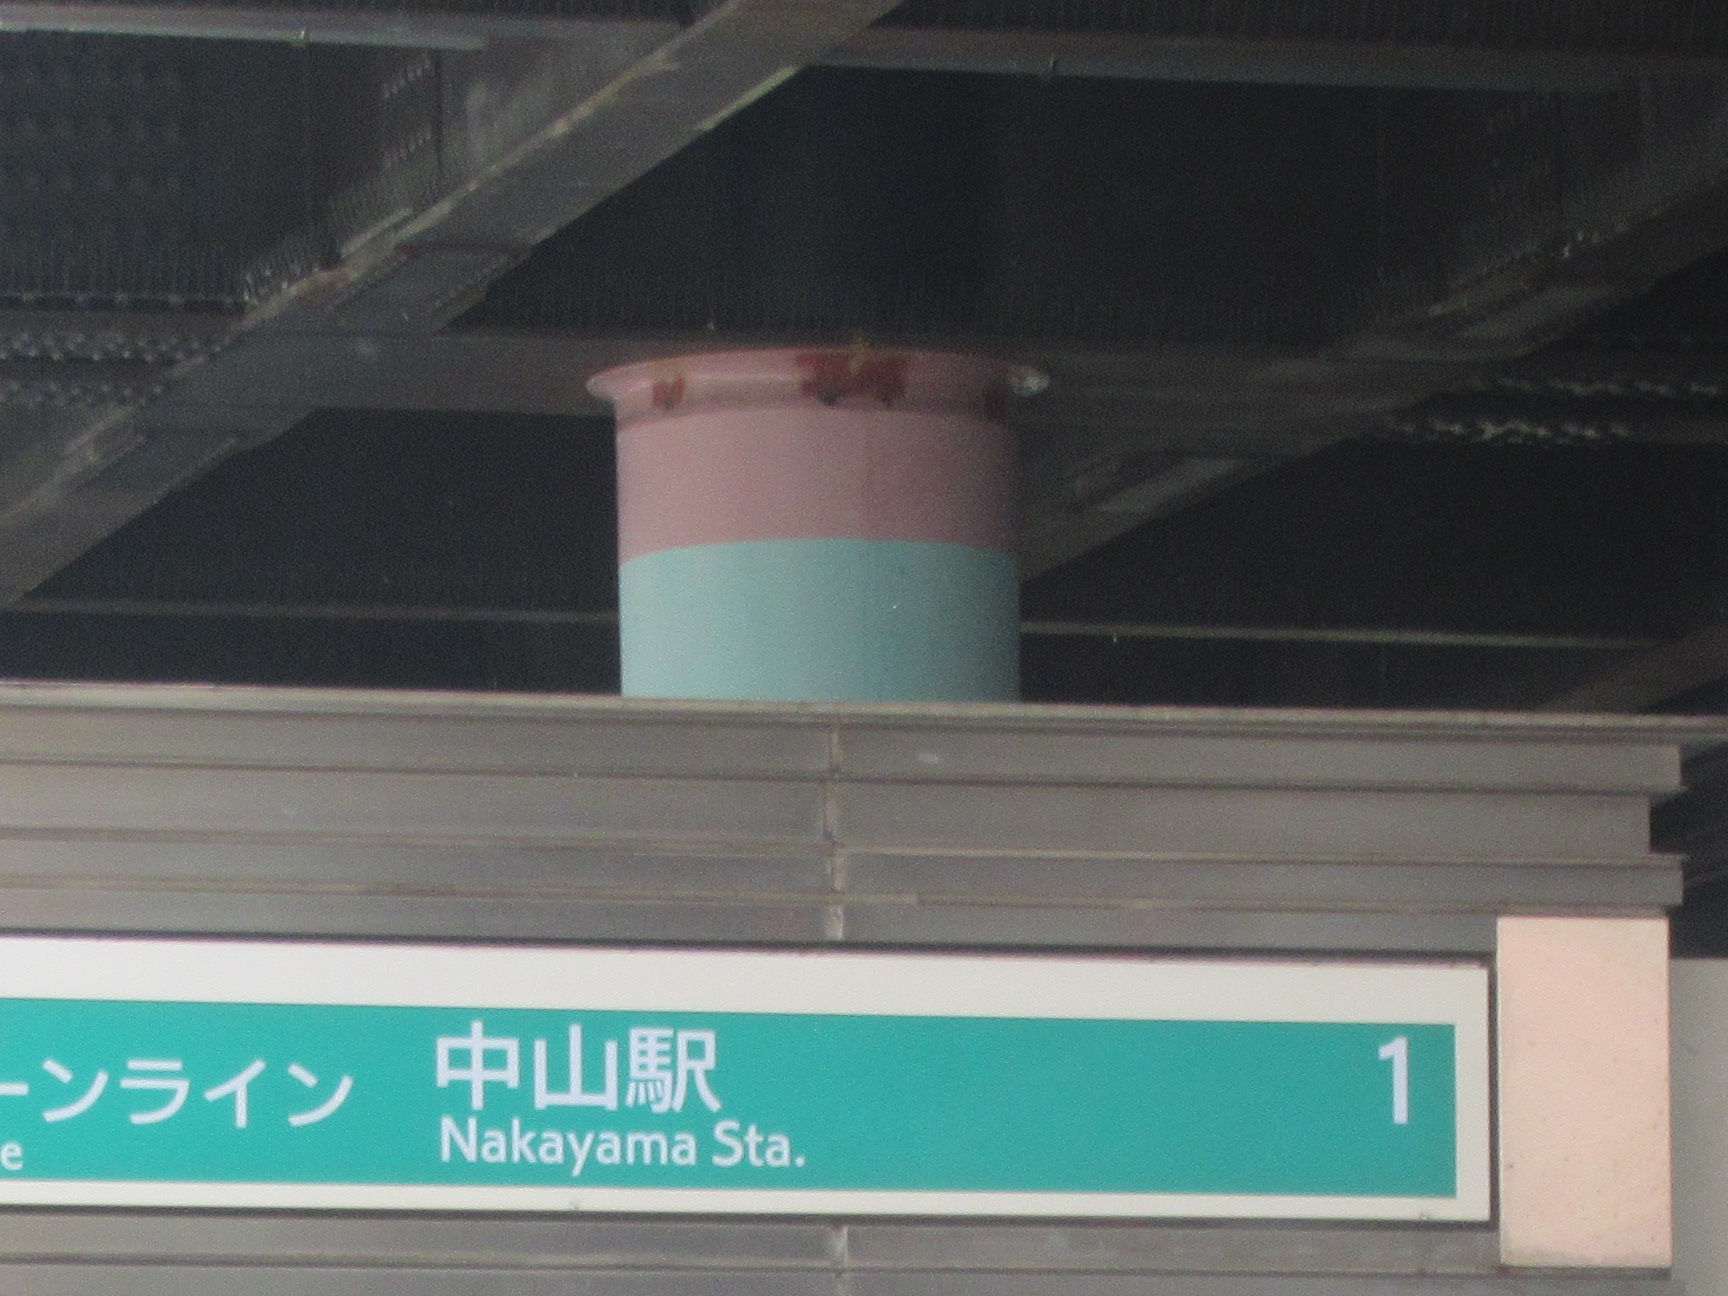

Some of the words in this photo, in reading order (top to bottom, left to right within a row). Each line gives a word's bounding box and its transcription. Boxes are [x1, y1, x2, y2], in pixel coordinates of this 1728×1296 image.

[436, 1020, 721, 1114] 中山駅
[1379, 1036, 1408, 1124] 1
[441, 1118, 696, 1177] Nakayama
[712, 1119, 806, 1168] Sta.
